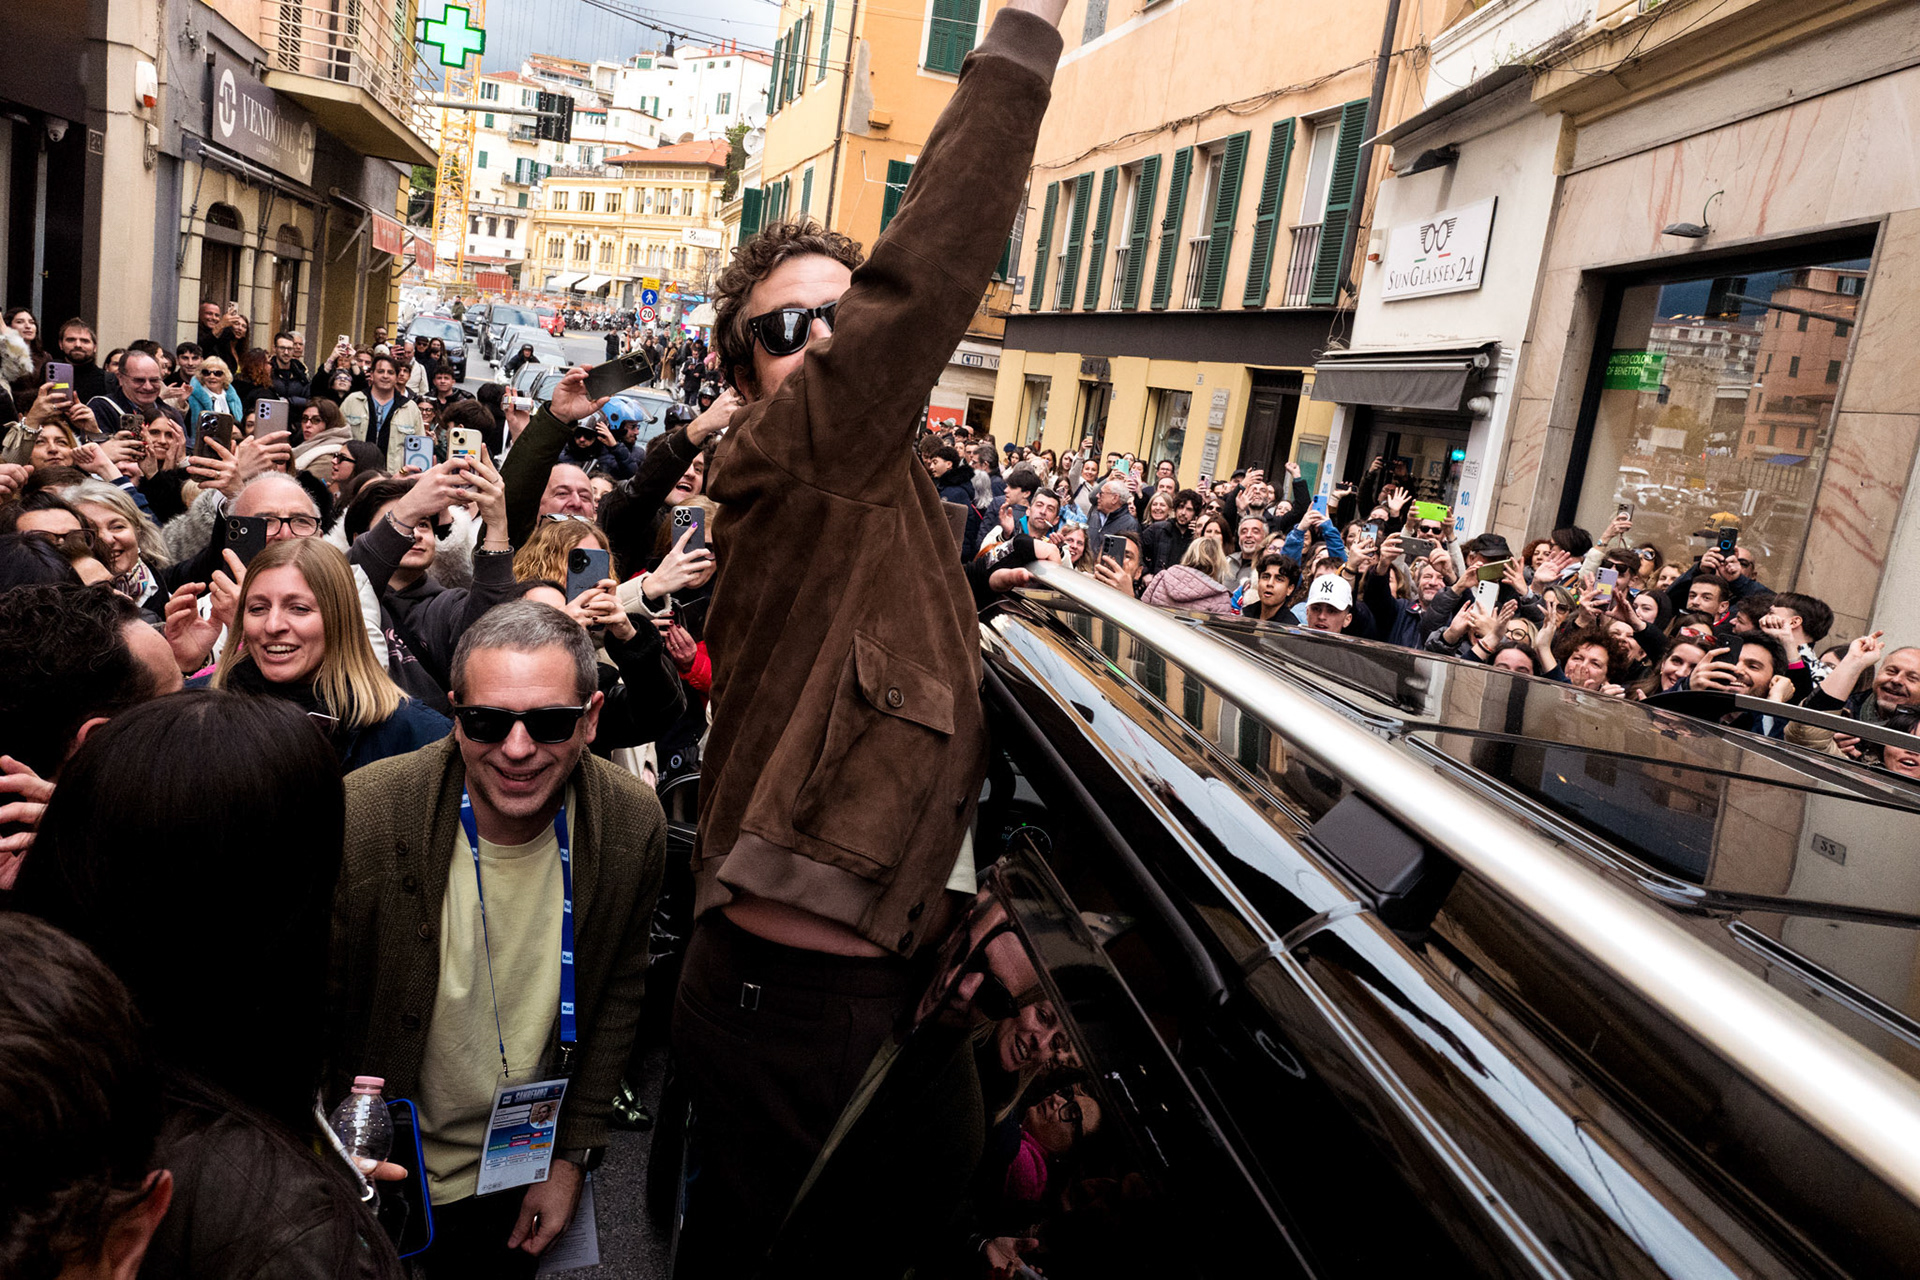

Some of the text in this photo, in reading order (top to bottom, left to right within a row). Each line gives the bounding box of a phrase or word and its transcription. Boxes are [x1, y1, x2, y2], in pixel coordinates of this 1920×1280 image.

[643, 310, 653, 319] 20
[963, 353, 981, 367] cm
[1609, 354, 1653, 365] UNITED COLORS
[1606, 365, 1645, 376] OF BENETTON
[1320, 581, 1334, 593] NY
